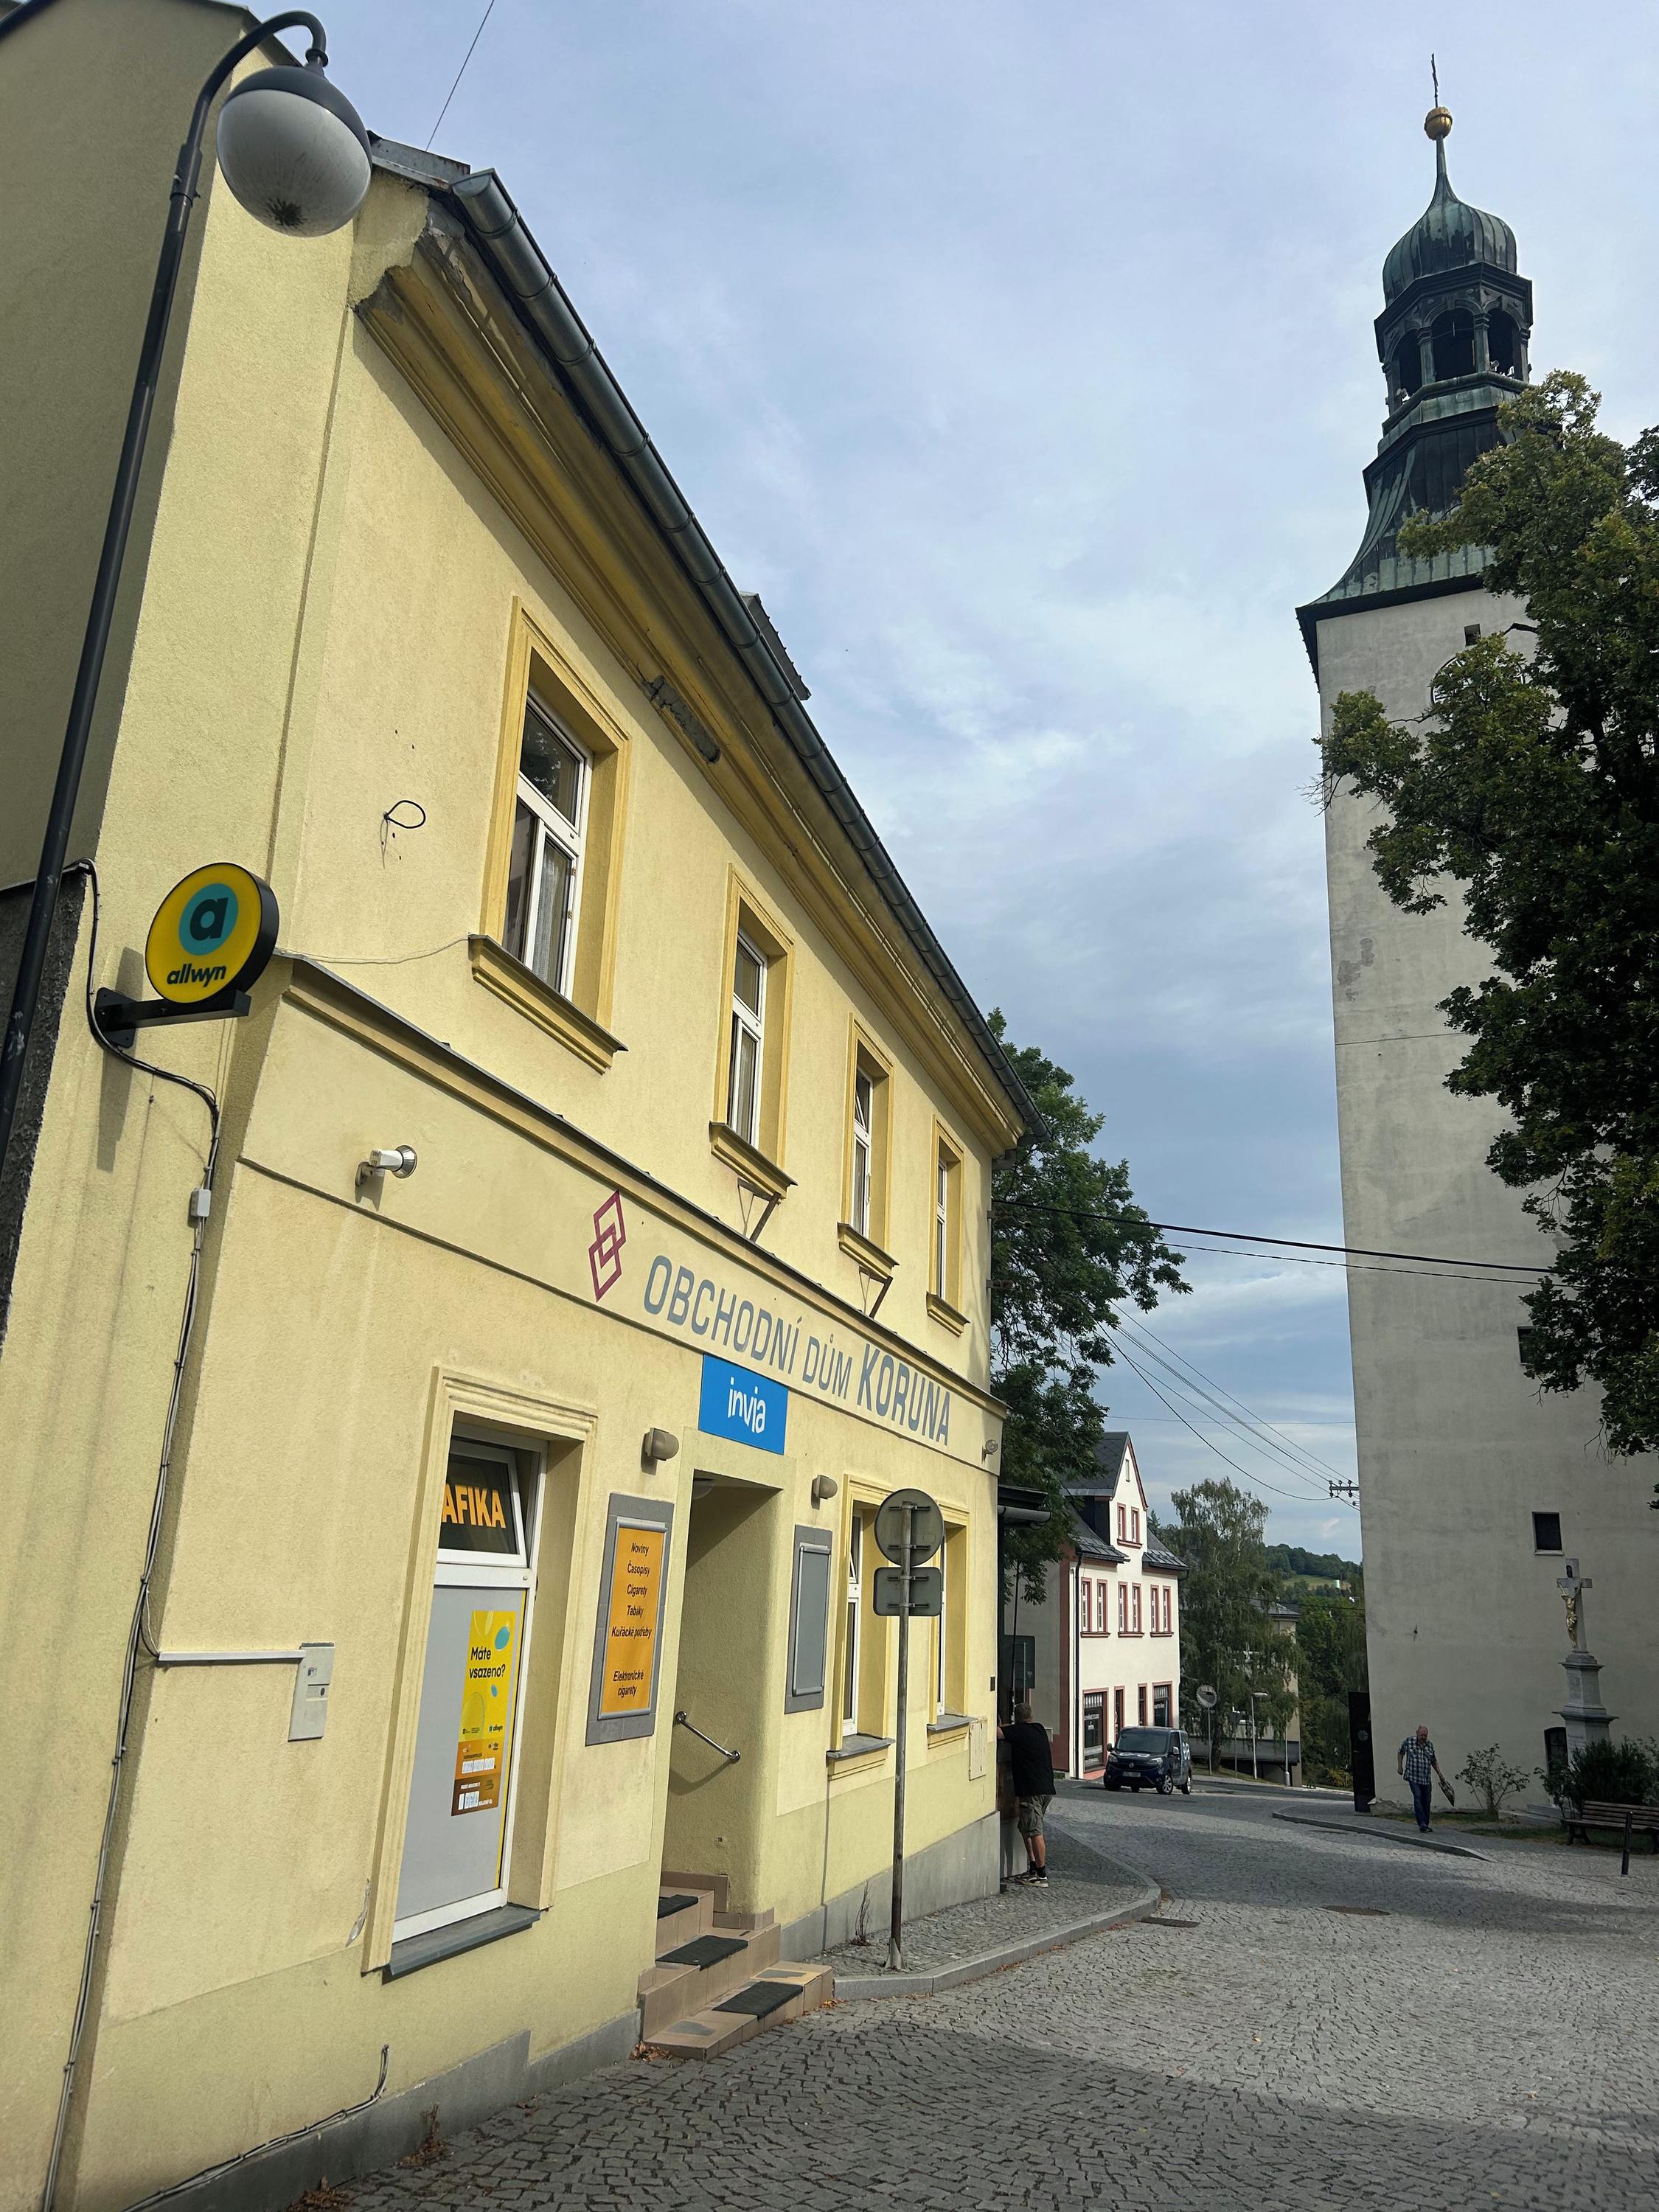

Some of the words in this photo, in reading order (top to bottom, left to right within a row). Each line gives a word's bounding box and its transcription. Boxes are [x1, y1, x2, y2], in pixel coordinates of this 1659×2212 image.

[189, 897, 229, 942] a
[167, 963, 226, 988] allwyn
[643, 1255, 802, 1375] OBCHODNÍ
[802, 1333, 853, 1399] DŮM
[856, 1343, 950, 1446] KORUNA
[728, 1377, 766, 1434] invia
[631, 1543, 649, 1557] Noviny
[627, 1560, 650, 1577] Časopisy
[627, 1584, 647, 1598] Cigarety
[627, 1605, 644, 1618] Tabáky
[611, 1626, 634, 1638] Kuřácké
[470, 1646, 491, 1660] Máte
[469, 1663, 506, 1679] vsazeno?
[613, 1669, 644, 1682] Elektronické
[618, 1685, 637, 1698] cigarety
